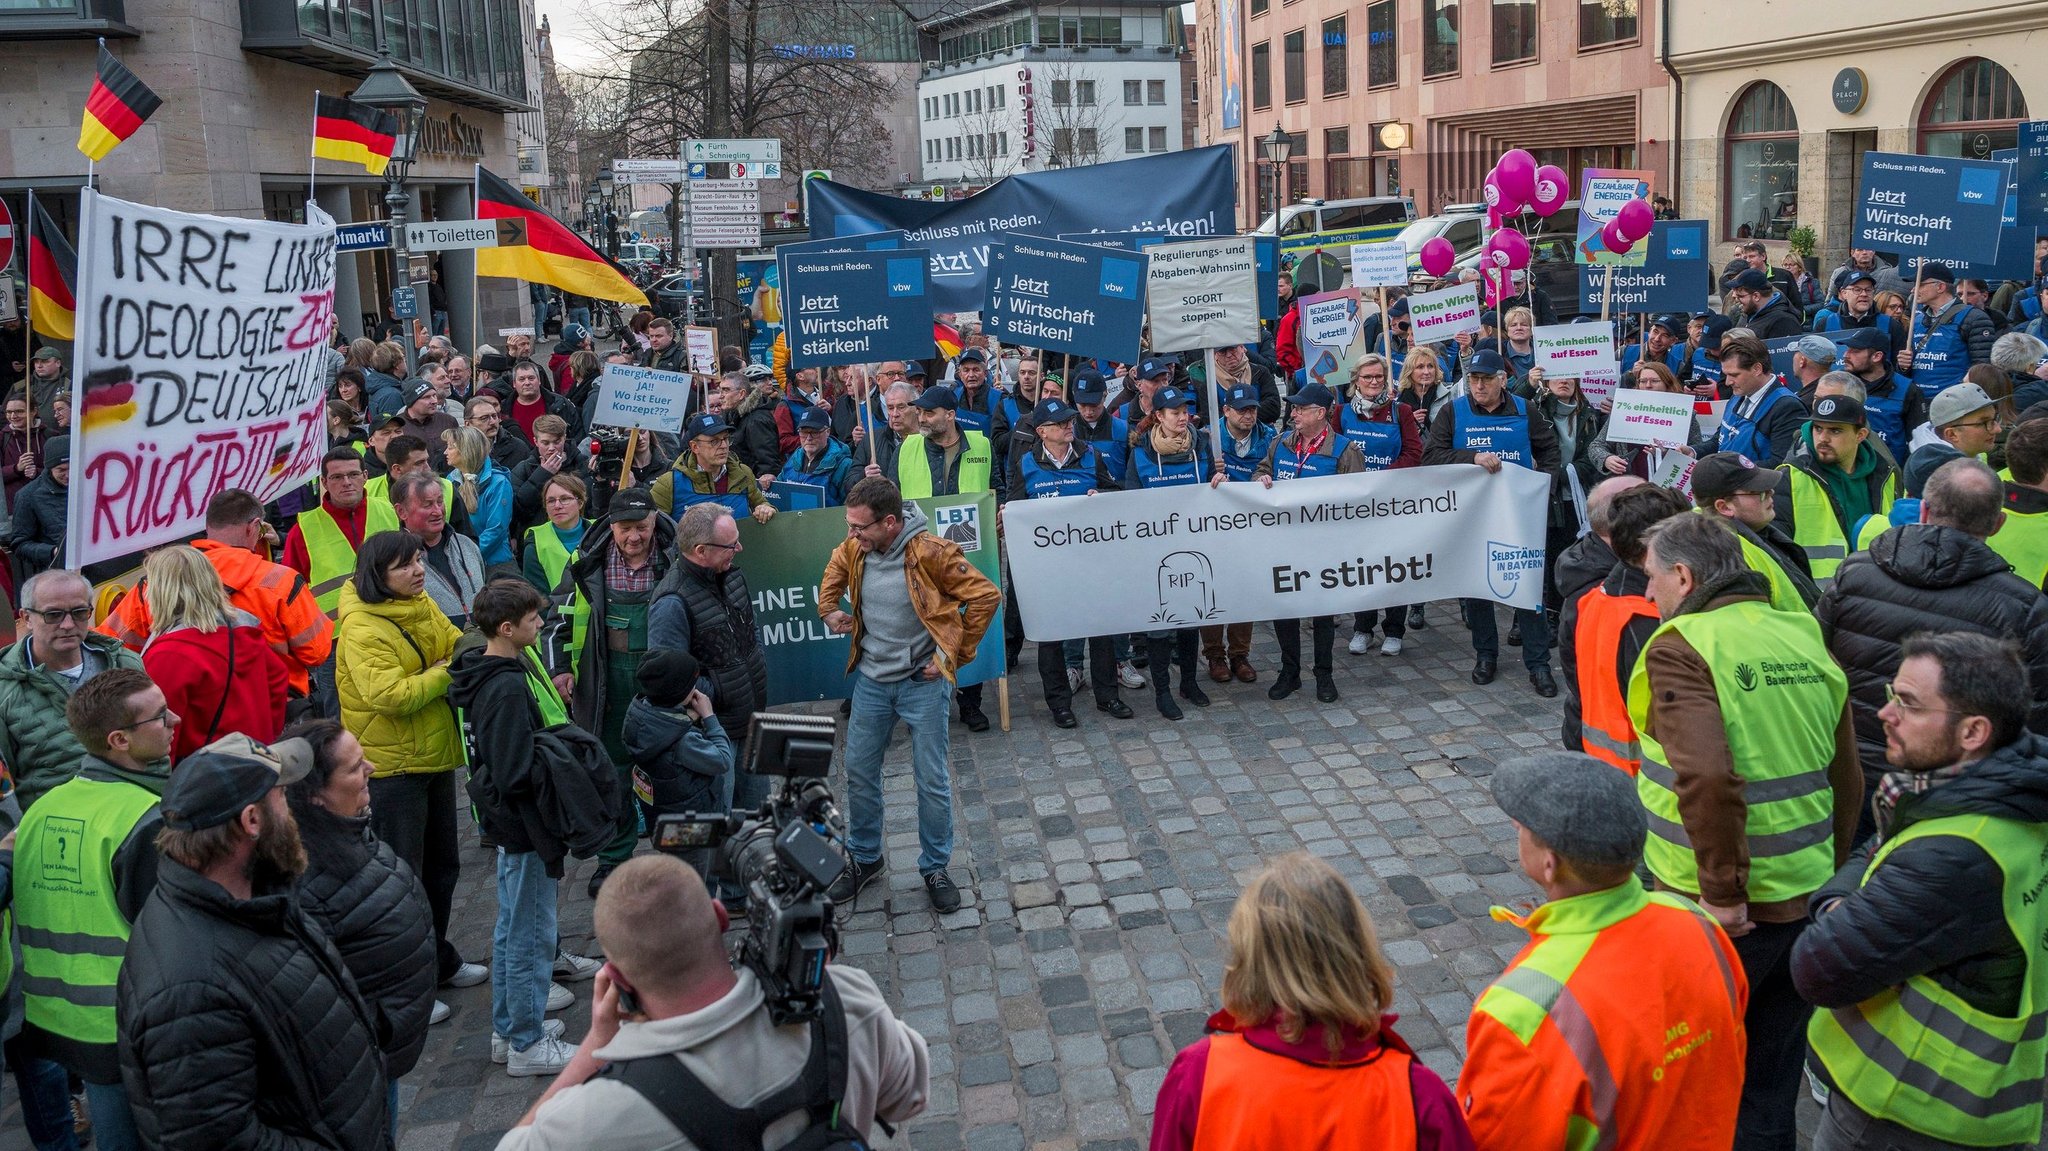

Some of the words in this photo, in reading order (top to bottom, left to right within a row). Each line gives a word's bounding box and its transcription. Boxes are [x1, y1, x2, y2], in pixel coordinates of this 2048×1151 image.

[1873, 161, 1903, 171] Schluss
[1919, 165, 1946, 174] Reden.
[1868, 188, 1906, 204] Jetzt
[1963, 190, 1982, 199] vbw
[904, 226, 959, 242] Schluss
[964, 219, 985, 235] mit
[990, 212, 1042, 230] Reden.
[1866, 208, 1952, 230] Wirtschaft
[427, 228, 496, 243] Toiletten
[1330, 234, 1360, 242] POLIZEI
[1863, 228, 1928, 246] stärken!
[112, 215, 250, 293] IRRE
[1014, 245, 1044, 257] Schluss
[1046, 249, 1062, 260] mit
[1064, 252, 1087, 263] Reden.
[1153, 248, 1223, 263] Regulierungs-
[1226, 244, 1245, 254] und
[845, 262, 873, 271] Reden.
[1150, 262, 1250, 279] Abgaben-Wahnsinn
[893, 283, 910, 292] vbw
[1010, 274, 1050, 294] Jetzt
[1105, 283, 1123, 293] vbw
[800, 294, 839, 311] Jetzt
[1182, 292, 1223, 306] SOFORT
[1412, 302, 1443, 314] Ohne
[1445, 294, 1476, 307] Wirte
[1588, 290, 1647, 303] strken!
[1010, 297, 1095, 325] Wirtschaft
[1182, 310, 1227, 323] stoppen!
[1310, 303, 1346, 315] BEZAHLBARE
[800, 315, 889, 334] Wirtschaft
[1417, 316, 1443, 328] kein
[1445, 309, 1475, 322] Essen
[97, 295, 293, 366] IDEOLOGIE
[1008, 319, 1073, 342] stärken!
[1318, 327, 1347, 340] Jetzt!!!
[802, 336, 870, 356] stärken!
[1556, 335, 1609, 346] einheitlich
[1551, 350, 1568, 358] auf
[612, 366, 683, 384] Energiewende
[636, 382, 654, 391] JA!!
[614, 390, 630, 400] Wo
[634, 393, 646, 402] ist
[649, 395, 671, 405] Euer
[612, 402, 669, 416] Konzept???
[1617, 402, 1631, 410] 7%
[1634, 404, 1688, 416] einheitlich
[1644, 416, 1672, 426] Essen
[1466, 436, 1492, 446] Jetzt
[1670, 464, 1680, 478] auf
[936, 507, 976, 524] LBT
[1034, 520, 1128, 548] Schaut
[1136, 512, 1180, 538] auf
[1188, 511, 1291, 533] unseren
[1300, 490, 1458, 523] Mittelstand!
[1273, 566, 1310, 593] Er
[1320, 553, 1433, 589] stirbt!
[1497, 562, 1506, 571] IN
[1508, 560, 1543, 570] BAYERN
[1168, 572, 1194, 588] RIP
[1503, 572, 1520, 581] BDS
[58, 837, 66, 860] ?
